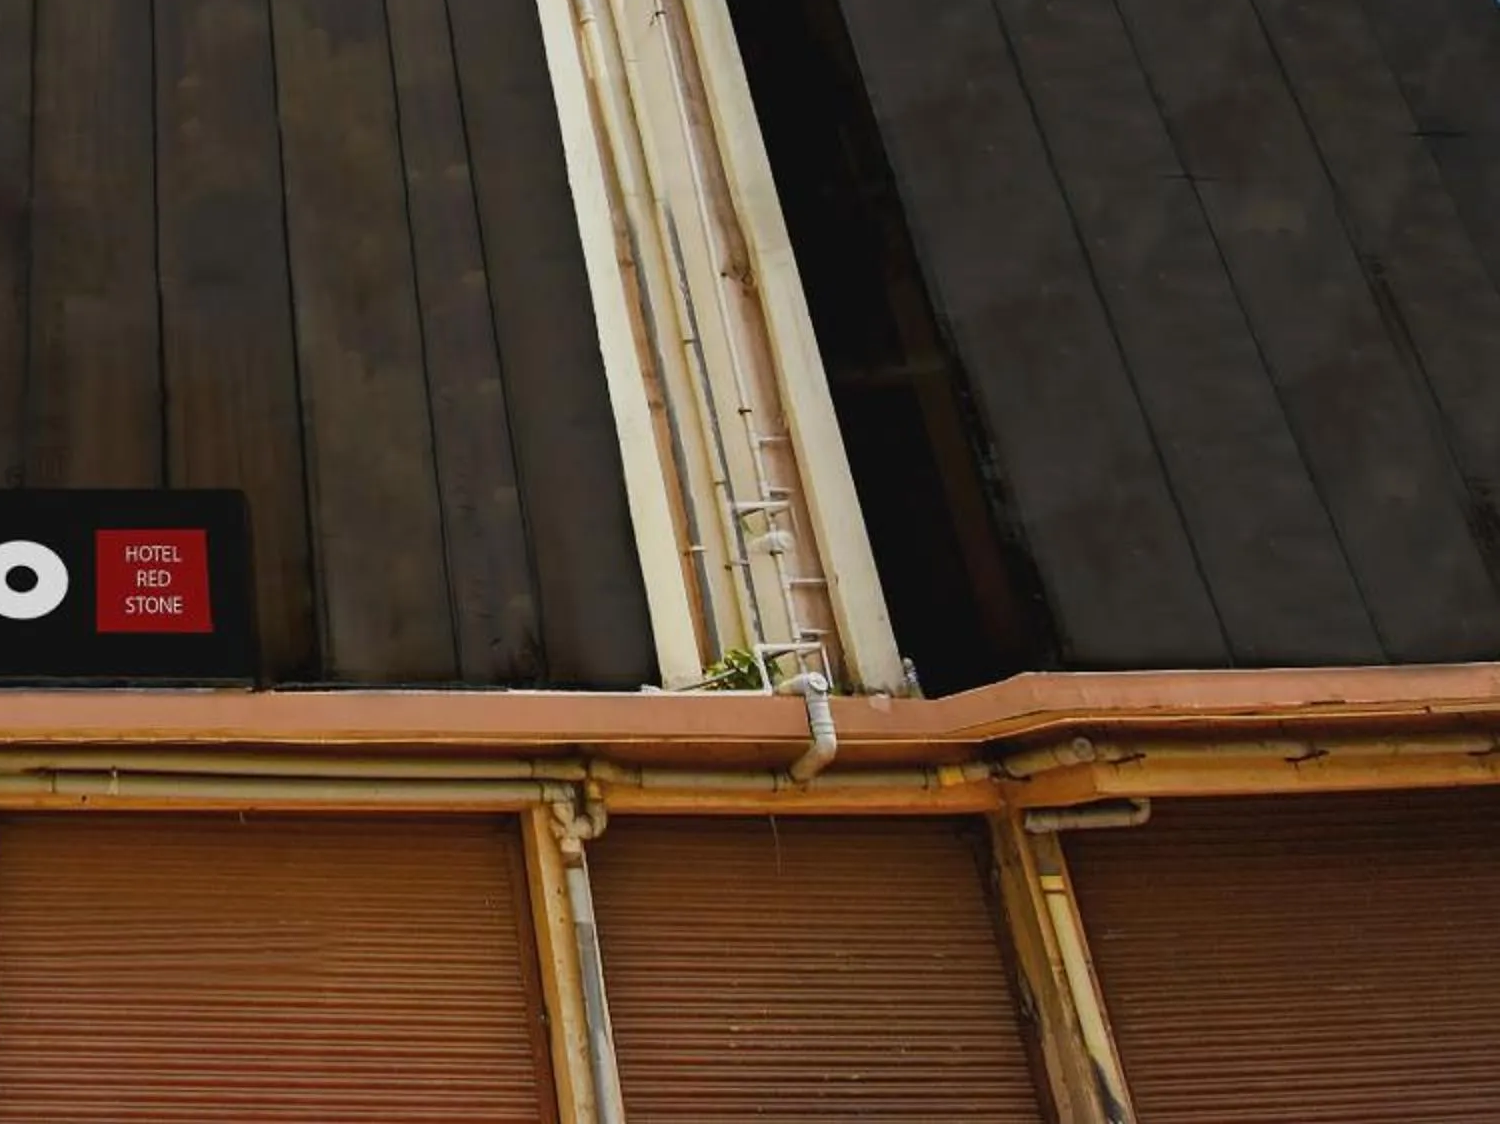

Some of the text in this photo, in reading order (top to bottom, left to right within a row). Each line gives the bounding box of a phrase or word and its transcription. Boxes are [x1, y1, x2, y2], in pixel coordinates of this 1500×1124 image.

[125, 545, 182, 563] HOTEL
[136, 569, 172, 588] RED
[125, 595, 183, 615] STONE
